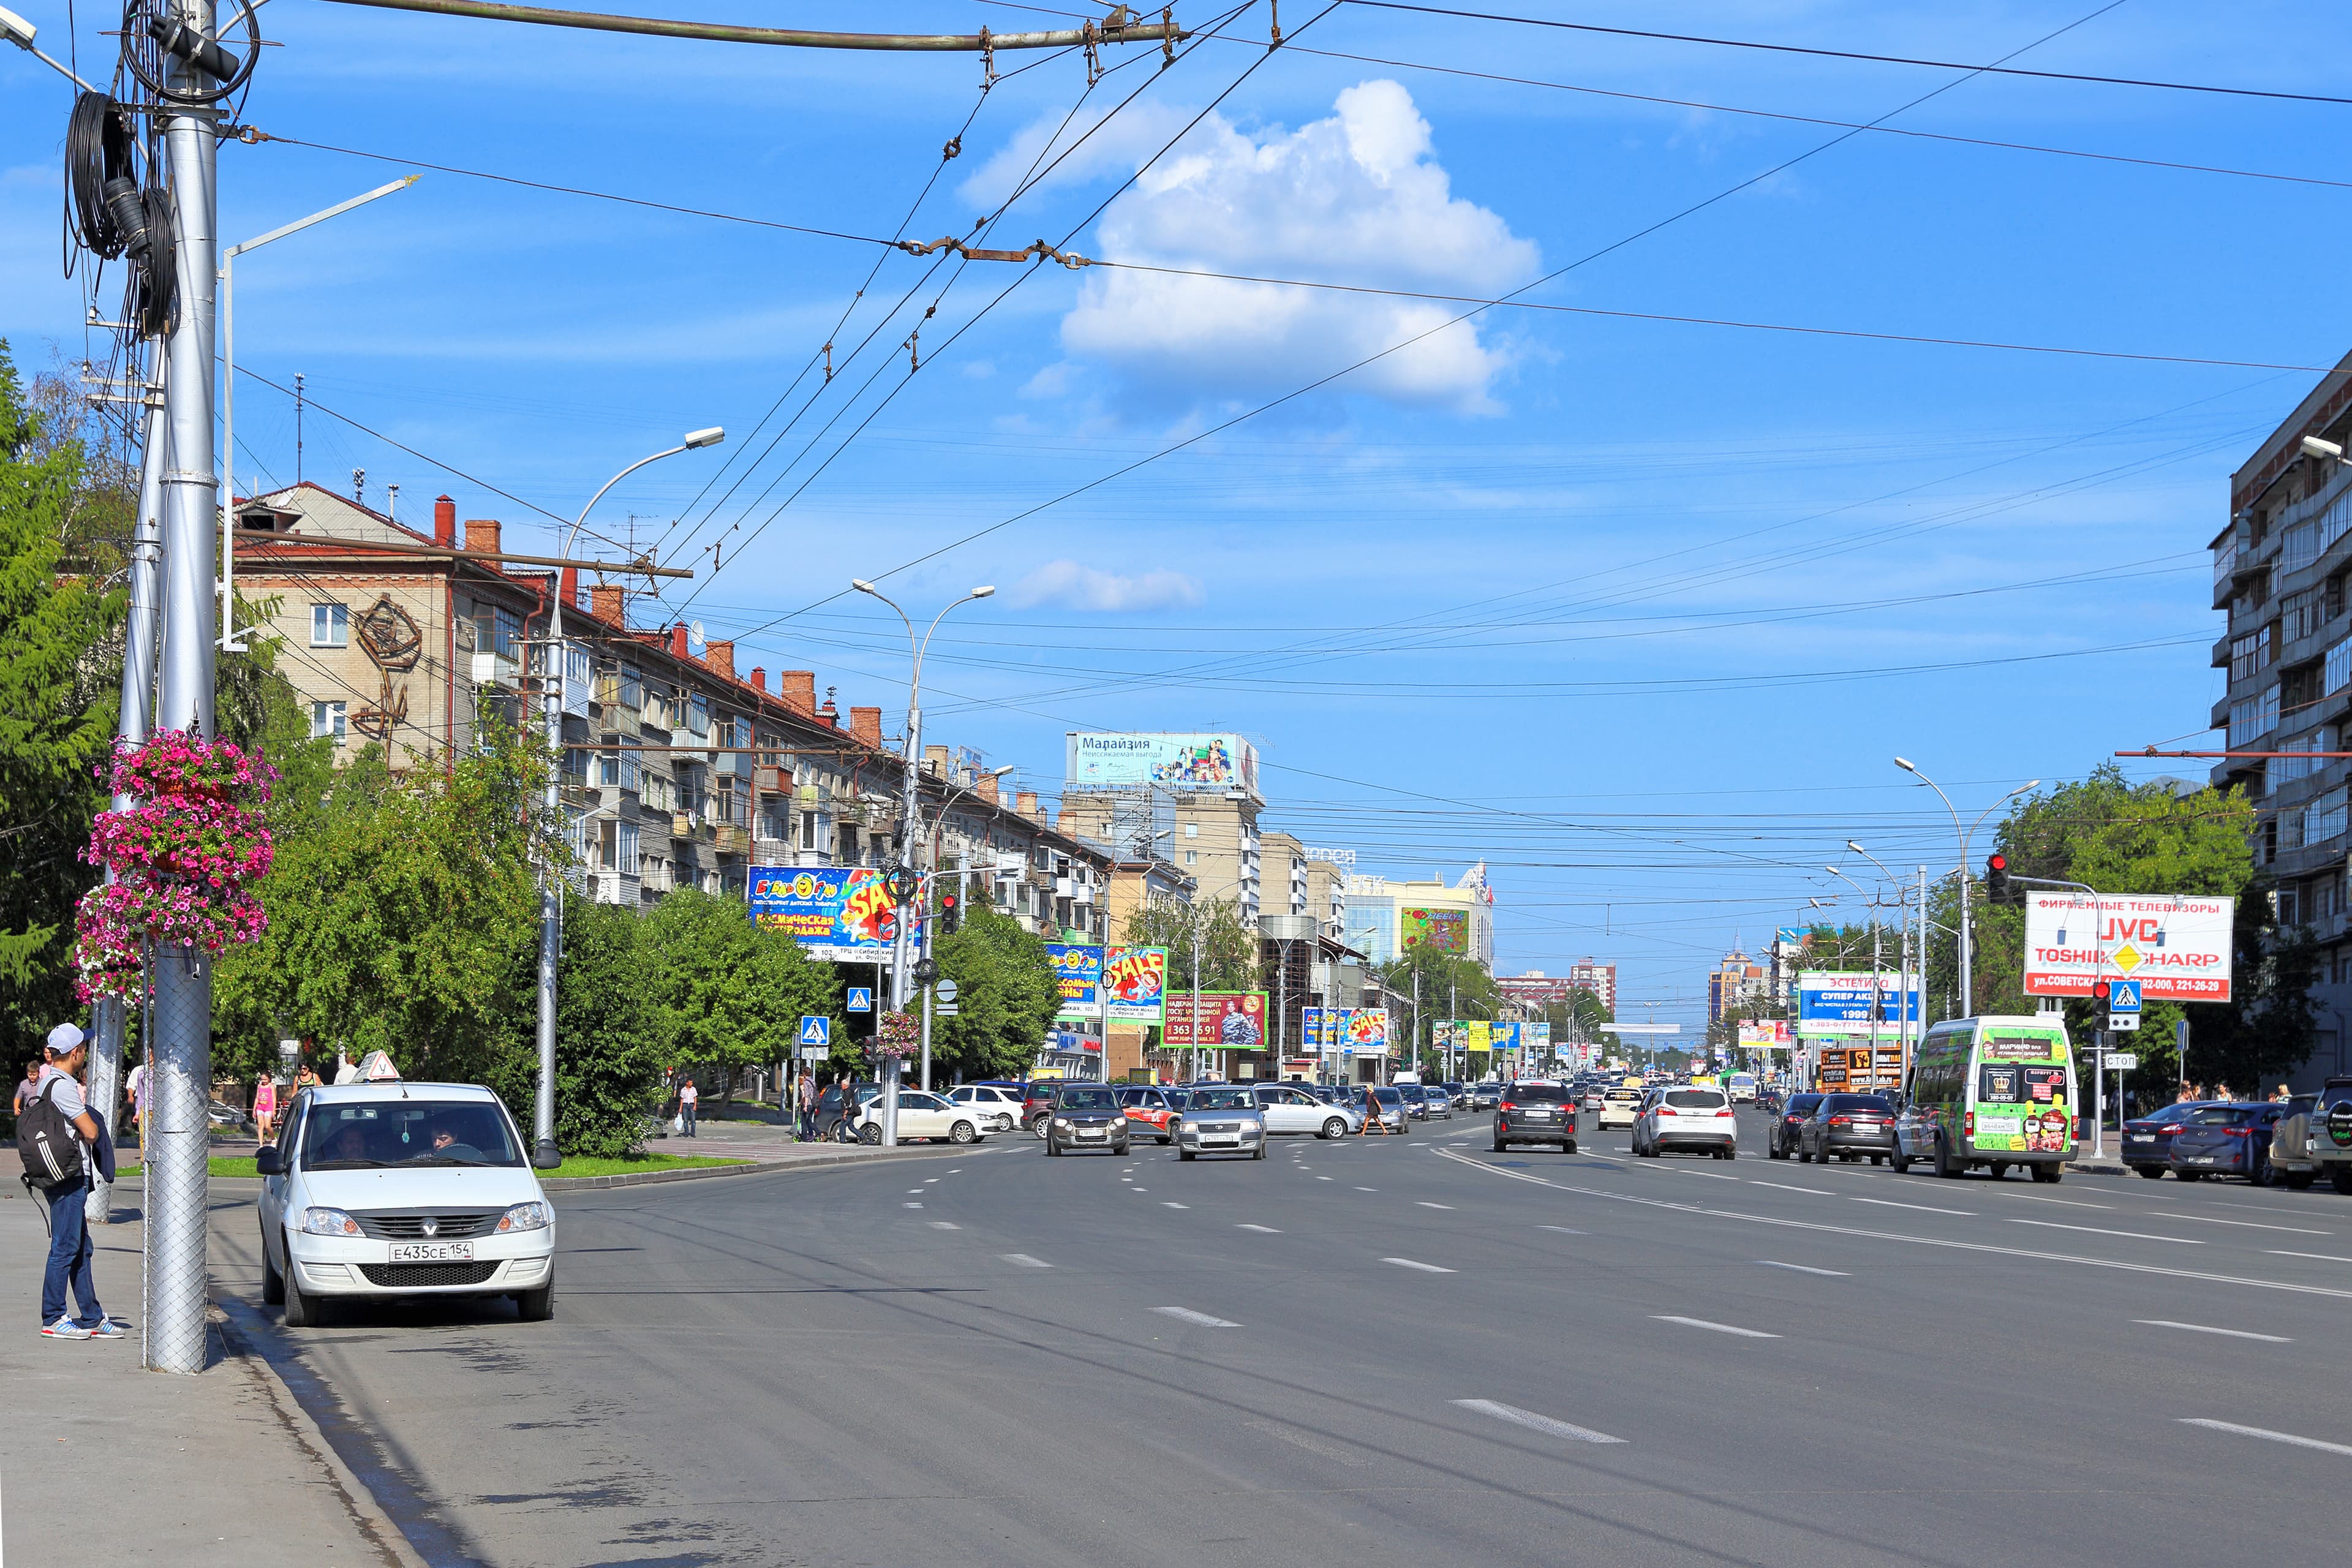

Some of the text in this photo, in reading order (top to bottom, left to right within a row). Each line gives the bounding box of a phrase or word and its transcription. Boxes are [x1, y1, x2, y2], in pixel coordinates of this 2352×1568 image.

[1082, 737, 1150, 749] Малайзия
[2038, 899, 2220, 914] ФИРМЕННЫЕ ТЕЛЕВИЗОРЫ
[1427, 912, 1464, 921] HEELYS
[2097, 918, 2158, 942] JVC
[2144, 952, 2220, 967] SHARP
[1109, 953, 1164, 985] SALE
[2176, 979, 2219, 992] 221-26-29
[1821, 992, 1854, 1001] СУПЕР
[1841, 1010, 1868, 1019] 1999
[1173, 1025, 1190, 1035] 363
[1204, 1025, 1215, 1035] 91
[379, 1063, 386, 1074] У
[394, 1243, 469, 1259] Е435СЕ 154
